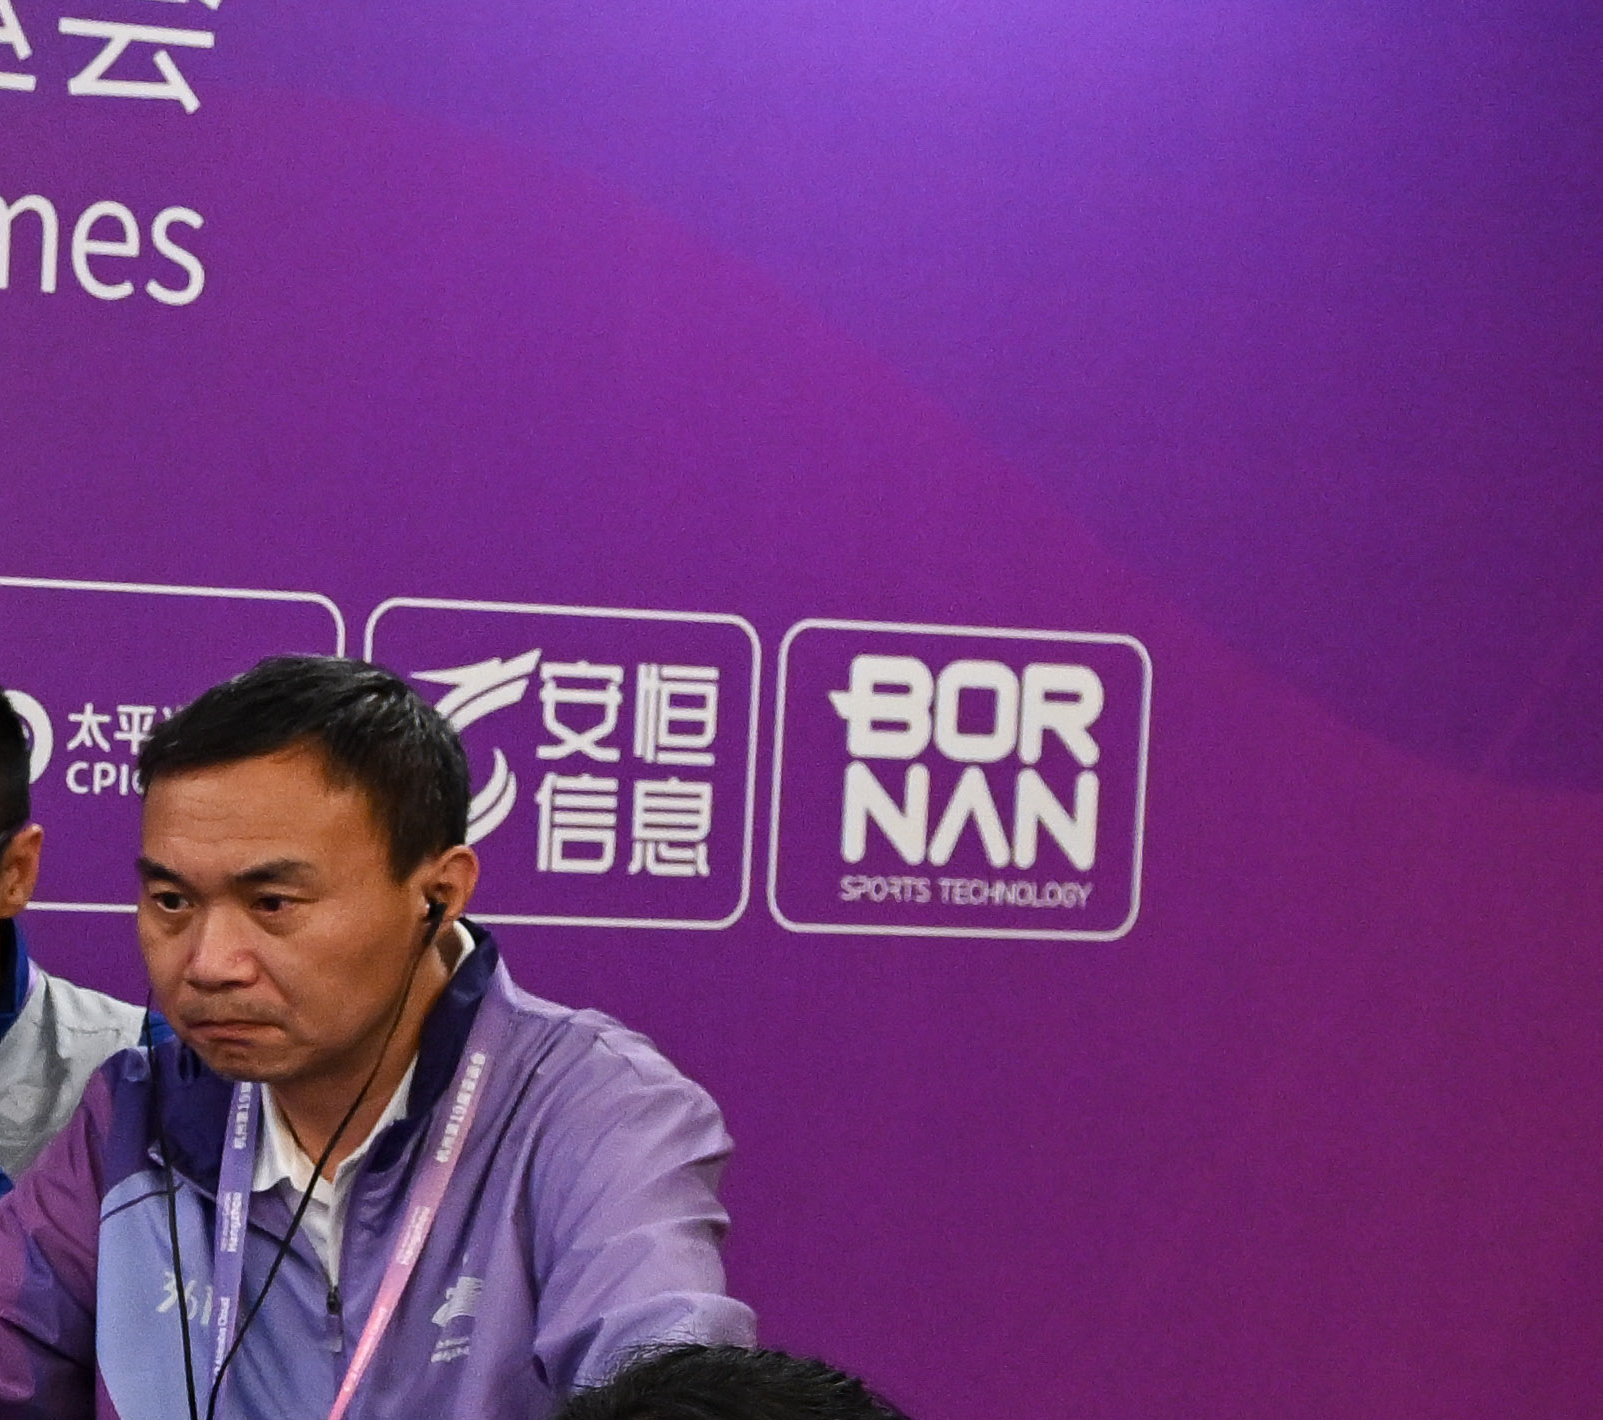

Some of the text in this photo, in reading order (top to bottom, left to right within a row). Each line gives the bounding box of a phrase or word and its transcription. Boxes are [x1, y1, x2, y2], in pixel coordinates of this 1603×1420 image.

[65, 701, 183, 756] 太平
[535, 660, 721, 766] 安恒
[828, 653, 1105, 769] BOR
[533, 771, 714, 877] 信息
[841, 760, 1101, 872] NAN
[840, 874, 1093, 909] SPORTS TECHNOLOGY
